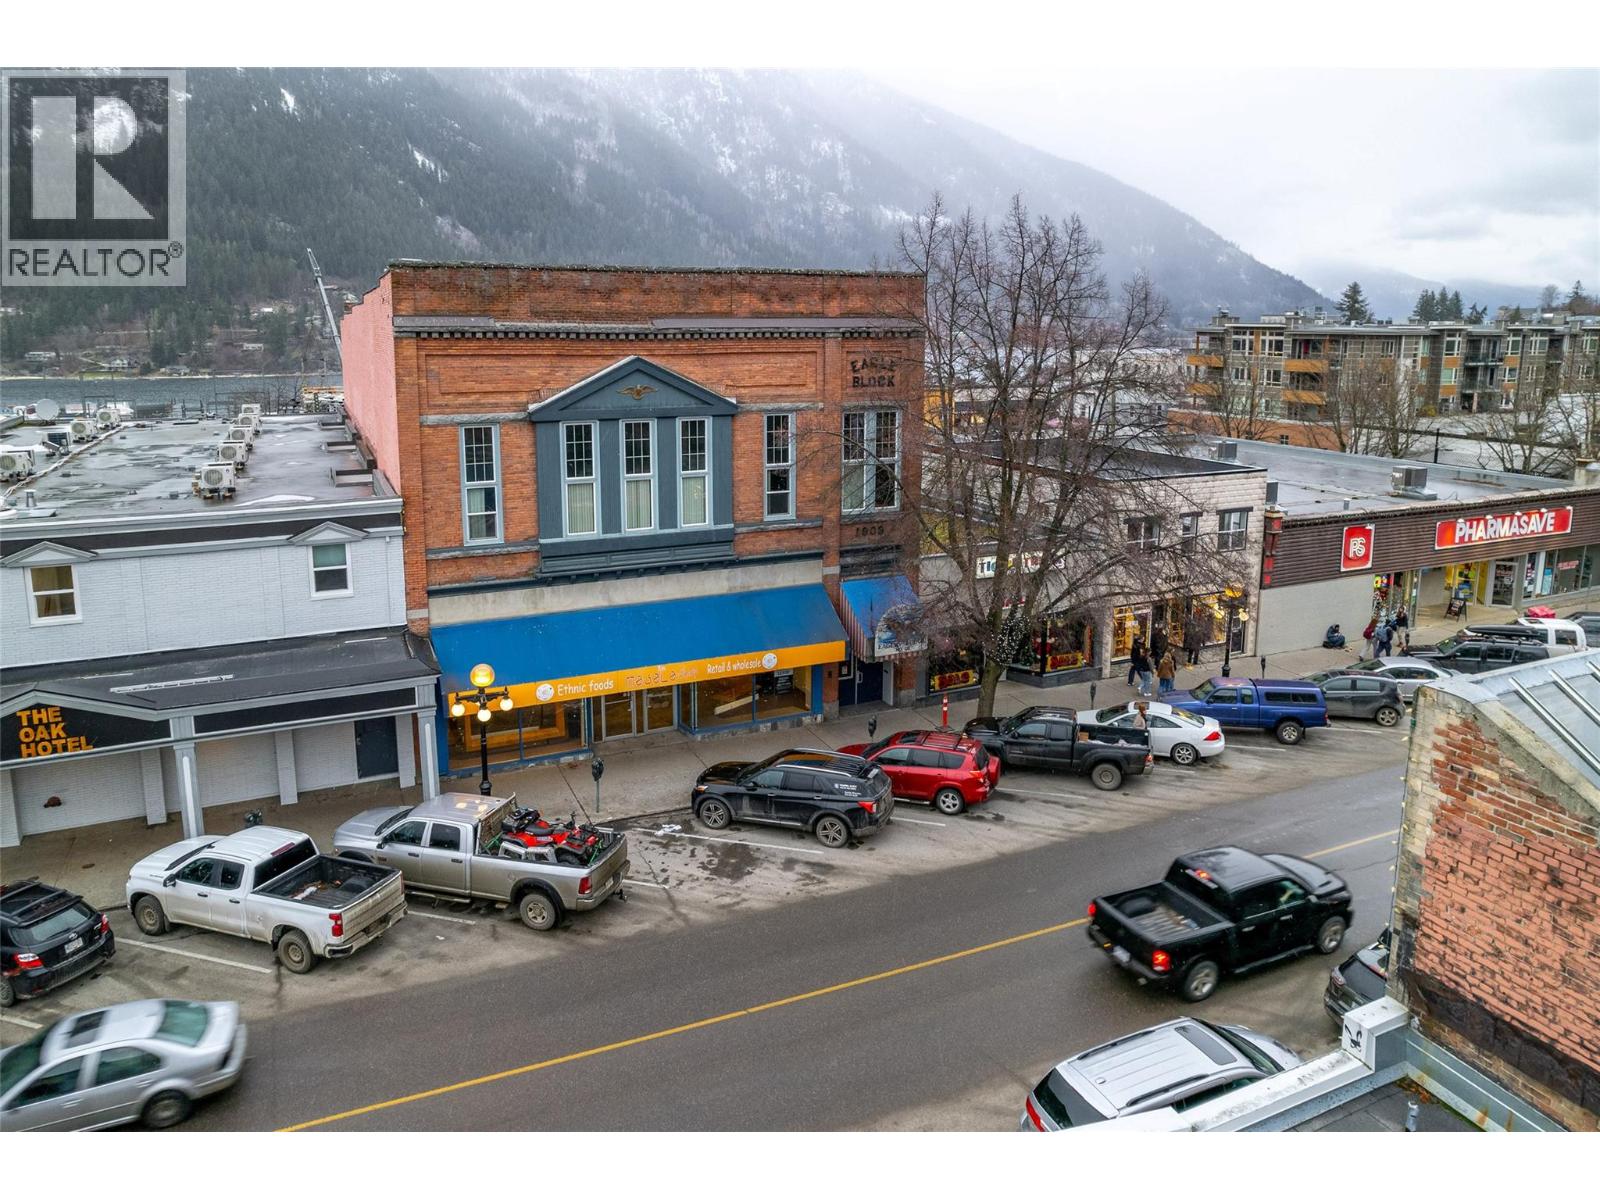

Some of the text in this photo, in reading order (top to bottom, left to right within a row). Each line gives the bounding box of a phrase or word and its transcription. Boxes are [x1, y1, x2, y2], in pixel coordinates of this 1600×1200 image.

[852, 376, 895, 388] BLOCK
[1454, 512, 1556, 544] PHARMASAVE
[1349, 537, 1367, 560] PS
[707, 663, 726, 674] Retail
[732, 658, 762, 671] wholesale
[557, 679, 614, 696] Ethnic foods
[16, 706, 62, 726] THE
[18, 723, 67, 743] OAK
[20, 735, 94, 758] HOTEL
